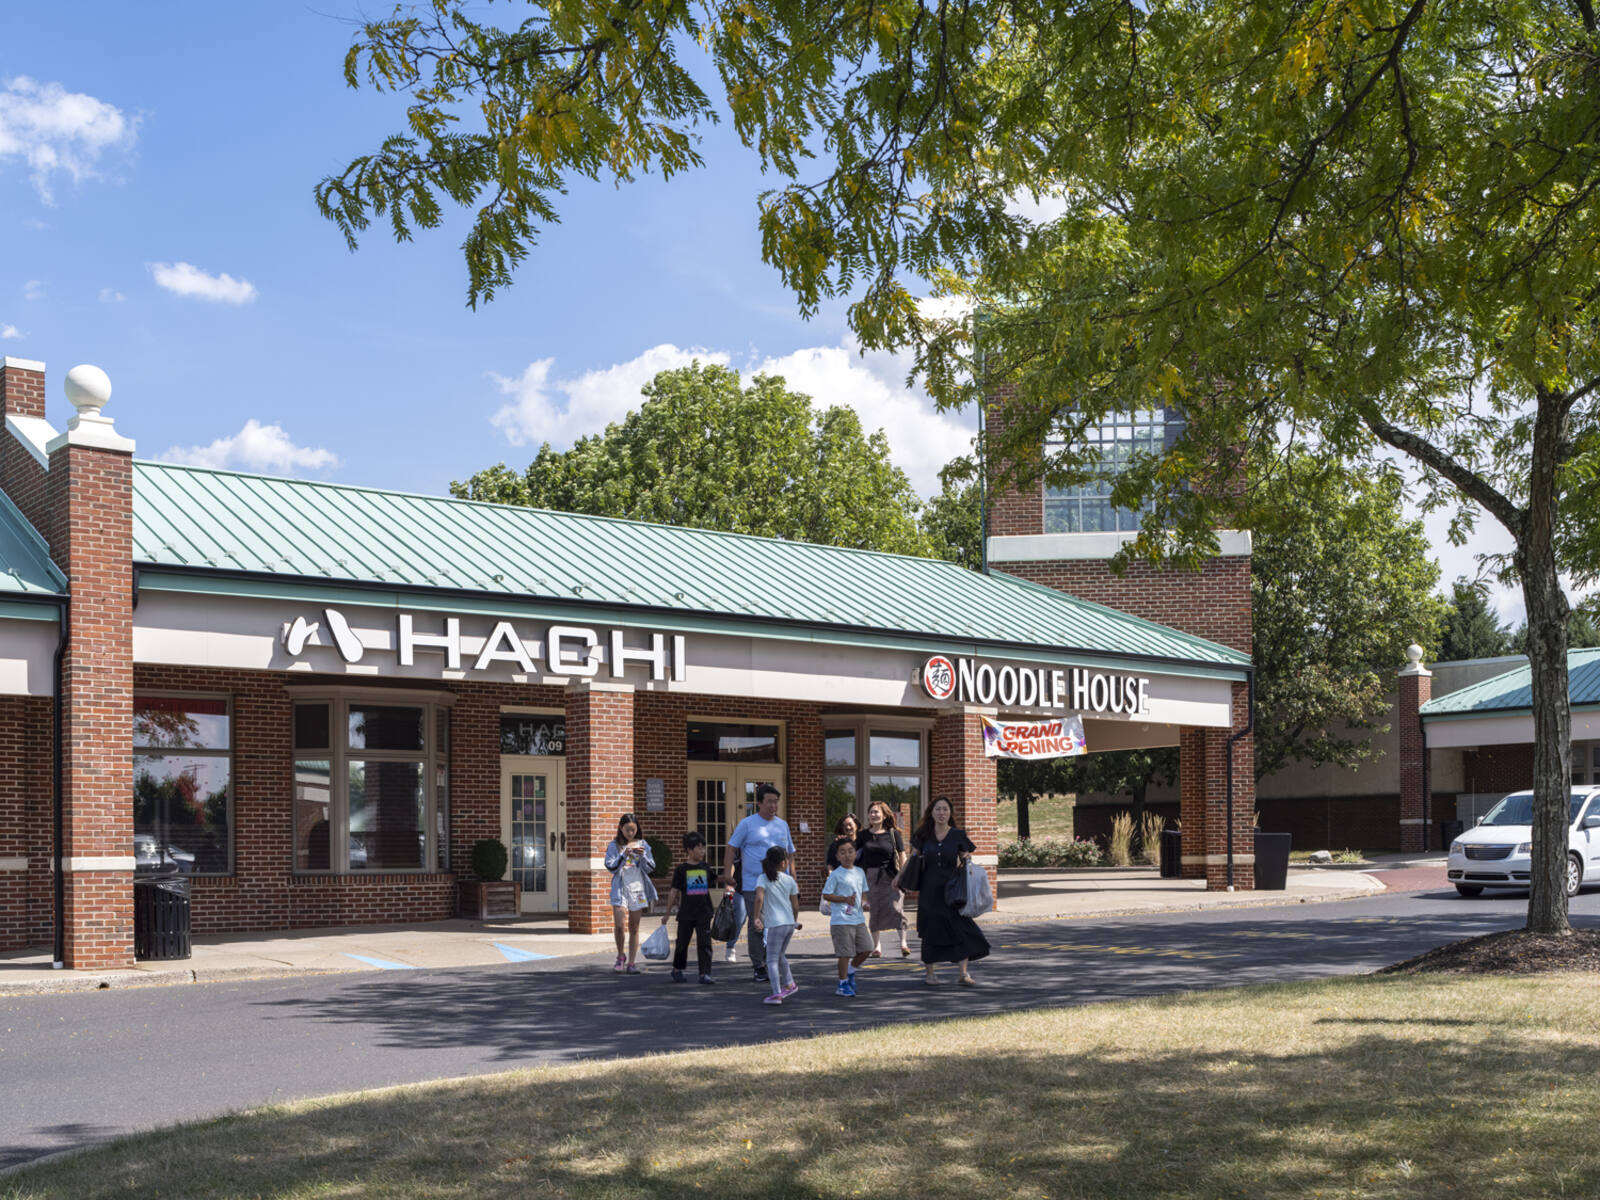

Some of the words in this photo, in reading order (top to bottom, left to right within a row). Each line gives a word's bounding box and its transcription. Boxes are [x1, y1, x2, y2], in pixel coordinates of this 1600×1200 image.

[397, 613, 687, 682] HACHI
[957, 657, 1065, 708] NOODLE
[1073, 667, 1150, 715] HOUSE
[1003, 722, 1063, 741] GRAND
